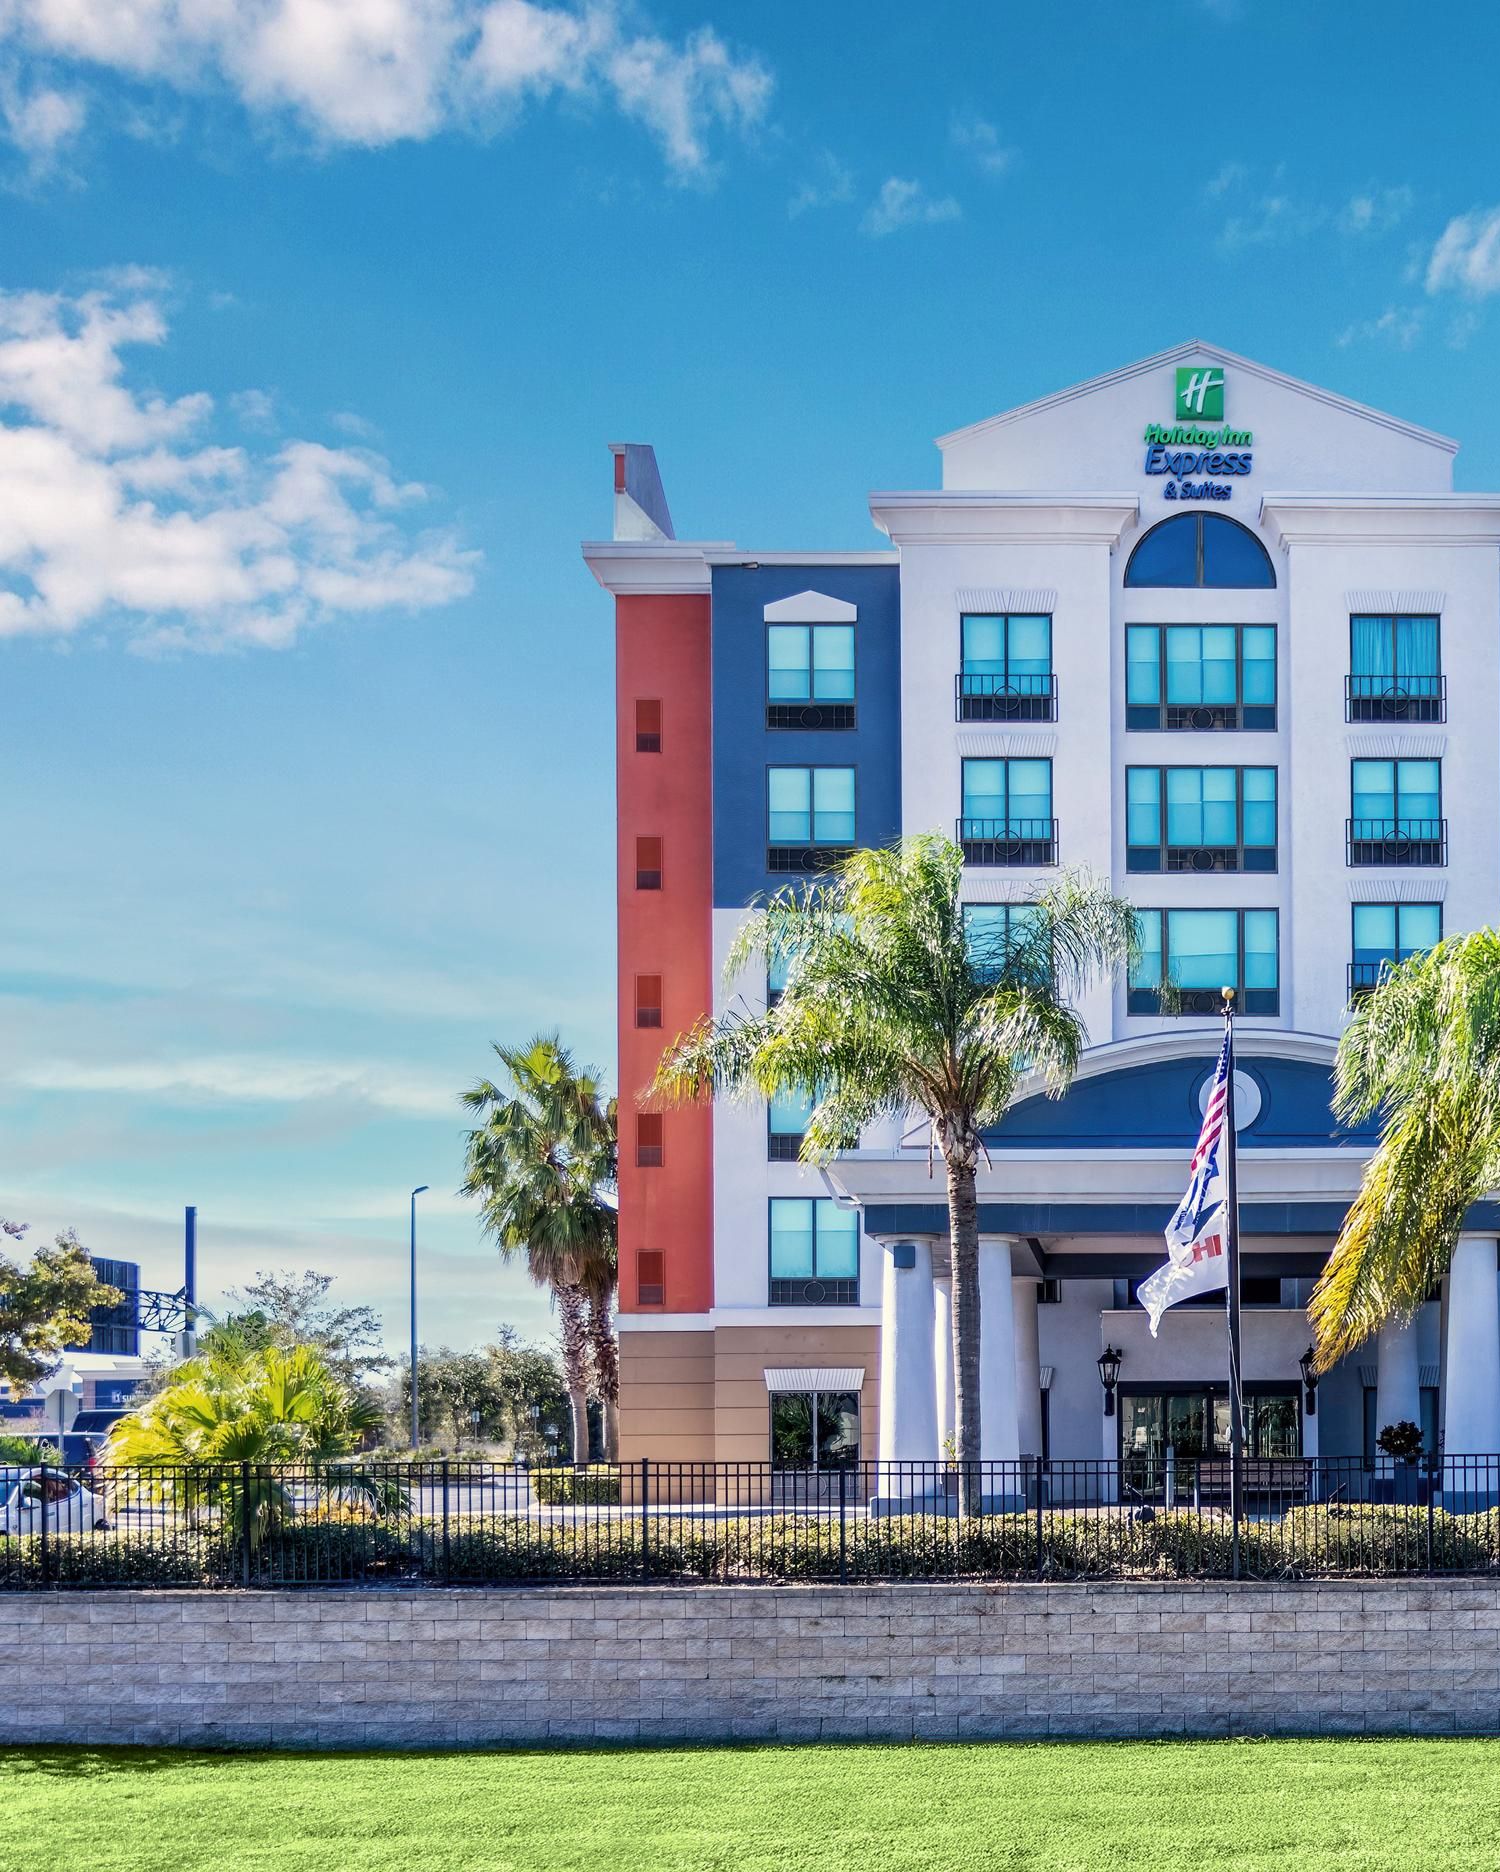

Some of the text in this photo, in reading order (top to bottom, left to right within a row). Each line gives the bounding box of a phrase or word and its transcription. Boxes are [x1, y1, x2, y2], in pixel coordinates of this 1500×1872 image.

[1144, 423, 1252, 450] Holiday Inn
[1145, 445, 1252, 481] Express
[1164, 480, 1232, 499] & Suites
